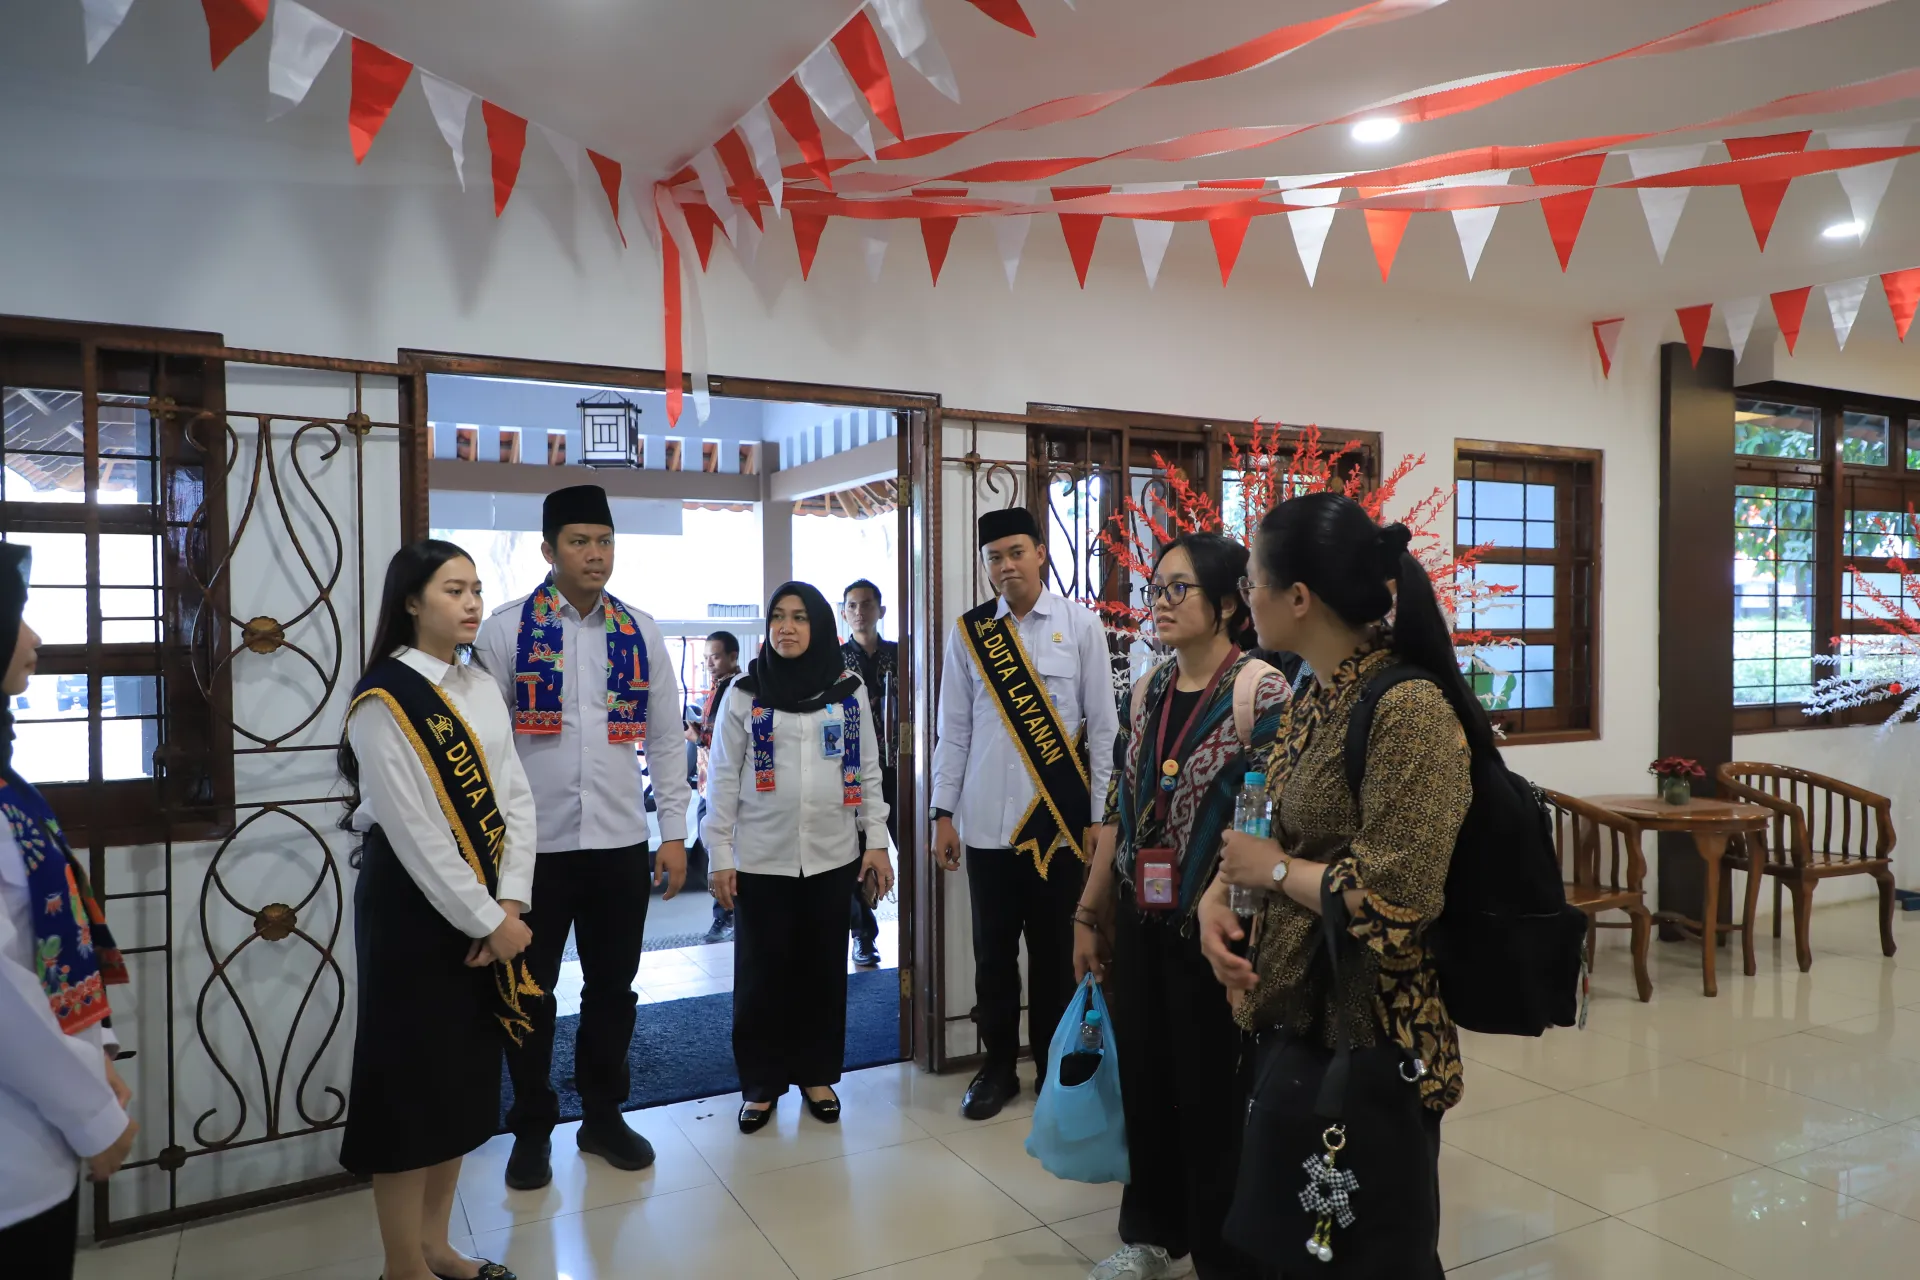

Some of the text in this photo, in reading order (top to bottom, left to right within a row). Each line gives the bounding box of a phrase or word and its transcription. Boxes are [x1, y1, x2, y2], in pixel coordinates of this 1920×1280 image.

[984, 633, 1064, 766] DUTA LAYANAN
[446, 741, 488, 808] DUTA
